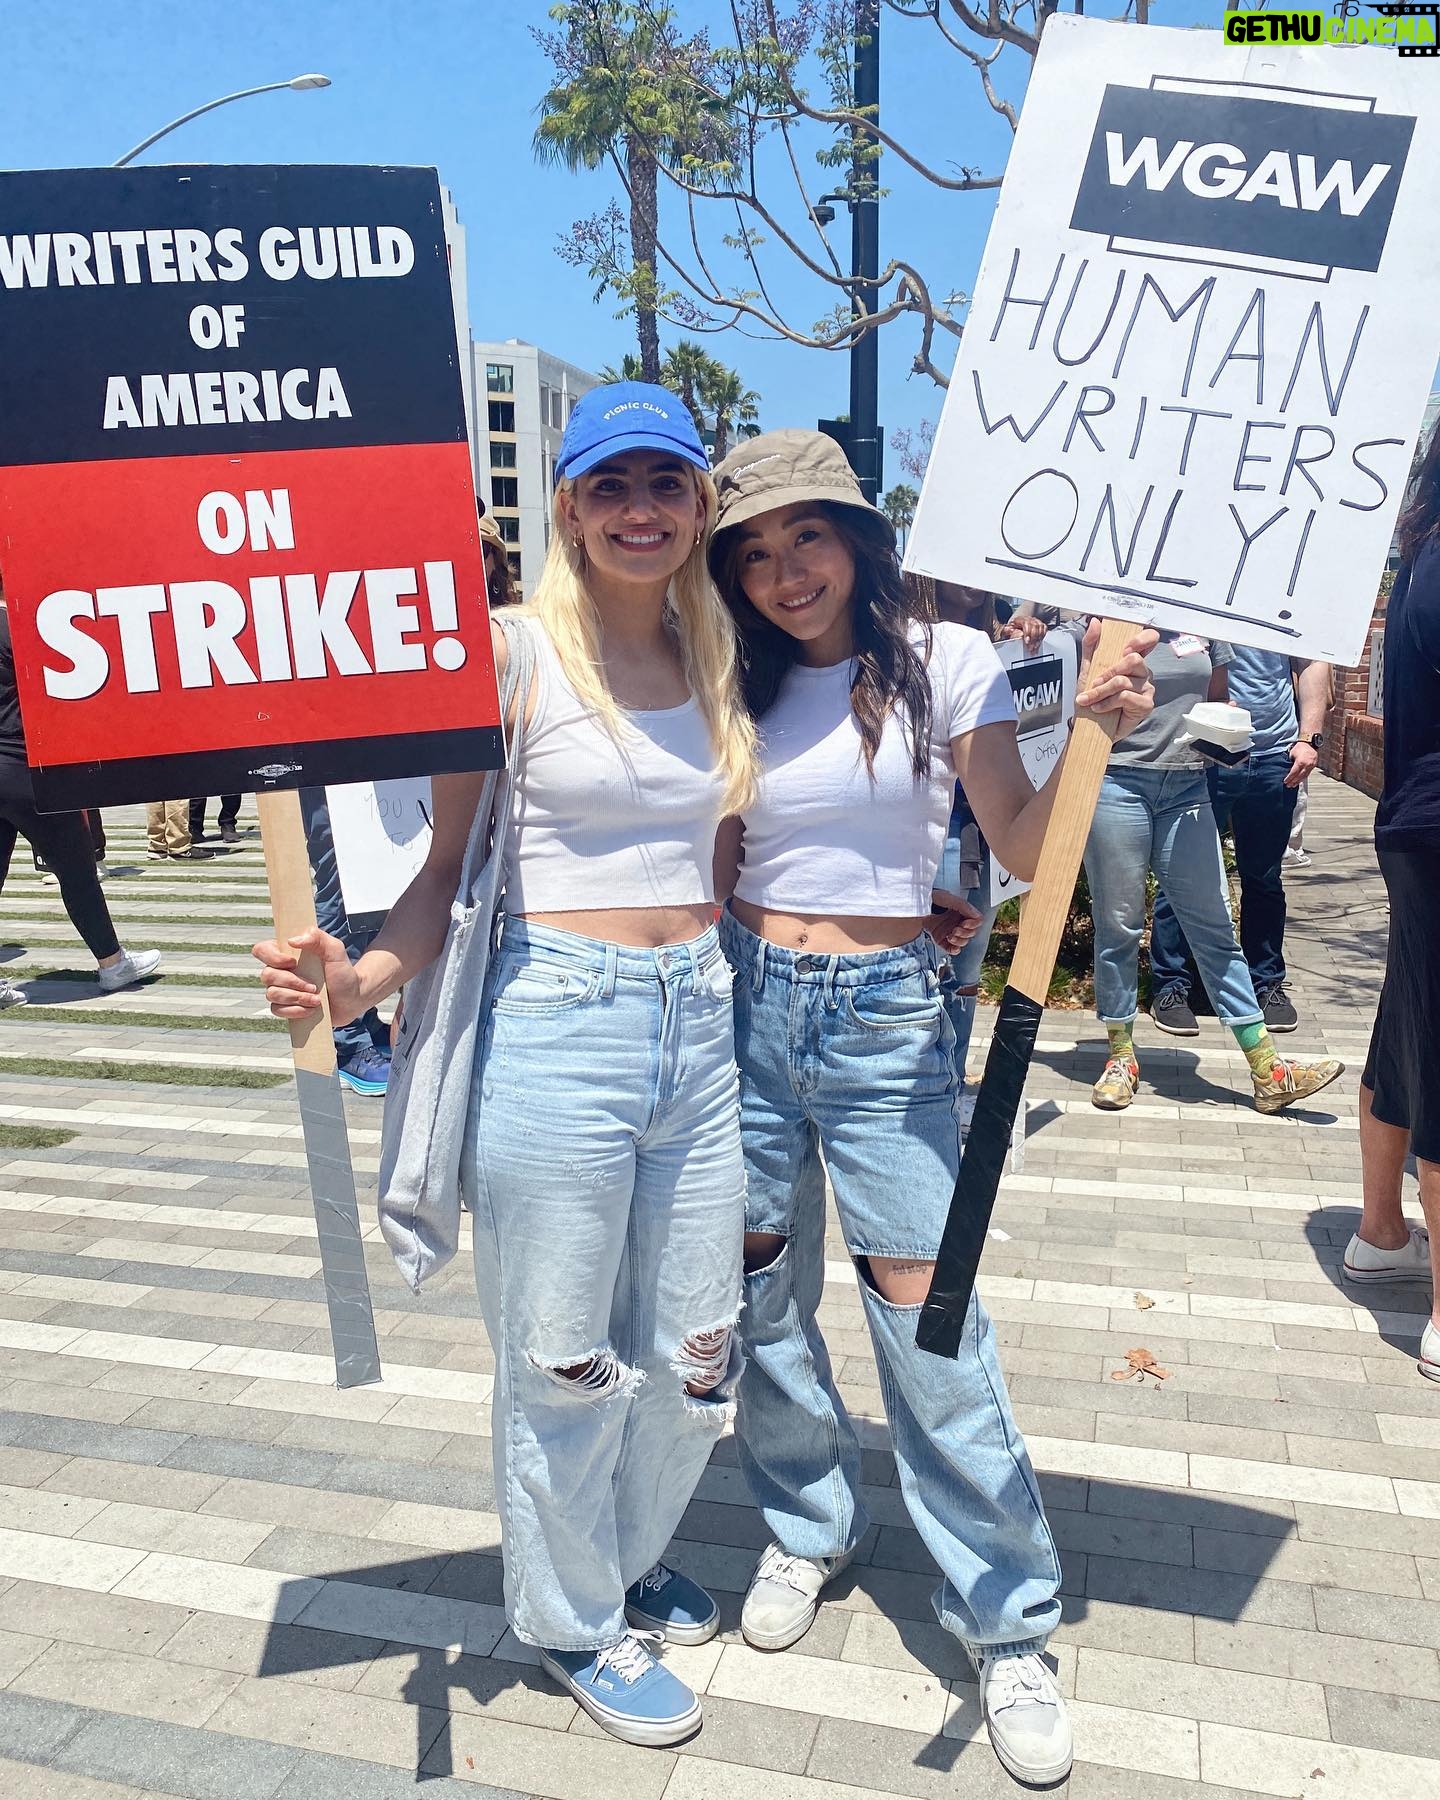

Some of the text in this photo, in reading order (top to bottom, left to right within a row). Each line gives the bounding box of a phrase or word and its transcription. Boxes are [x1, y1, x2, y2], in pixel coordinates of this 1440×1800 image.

[1104, 130, 1393, 218] WGAW
[0, 226, 415, 289] WRITERS GUILD
[189, 304, 246, 350] OF
[989, 247, 1371, 417] HUMAN
[103, 367, 353, 430] AMERICA
[603, 401, 669, 420] PICNIC CLUB
[971, 369, 1406, 512] WRITERS
[197, 488, 295, 556] ON
[1000, 468, 1317, 621] ONLY!
[36, 560, 466, 701] STRIKE!
